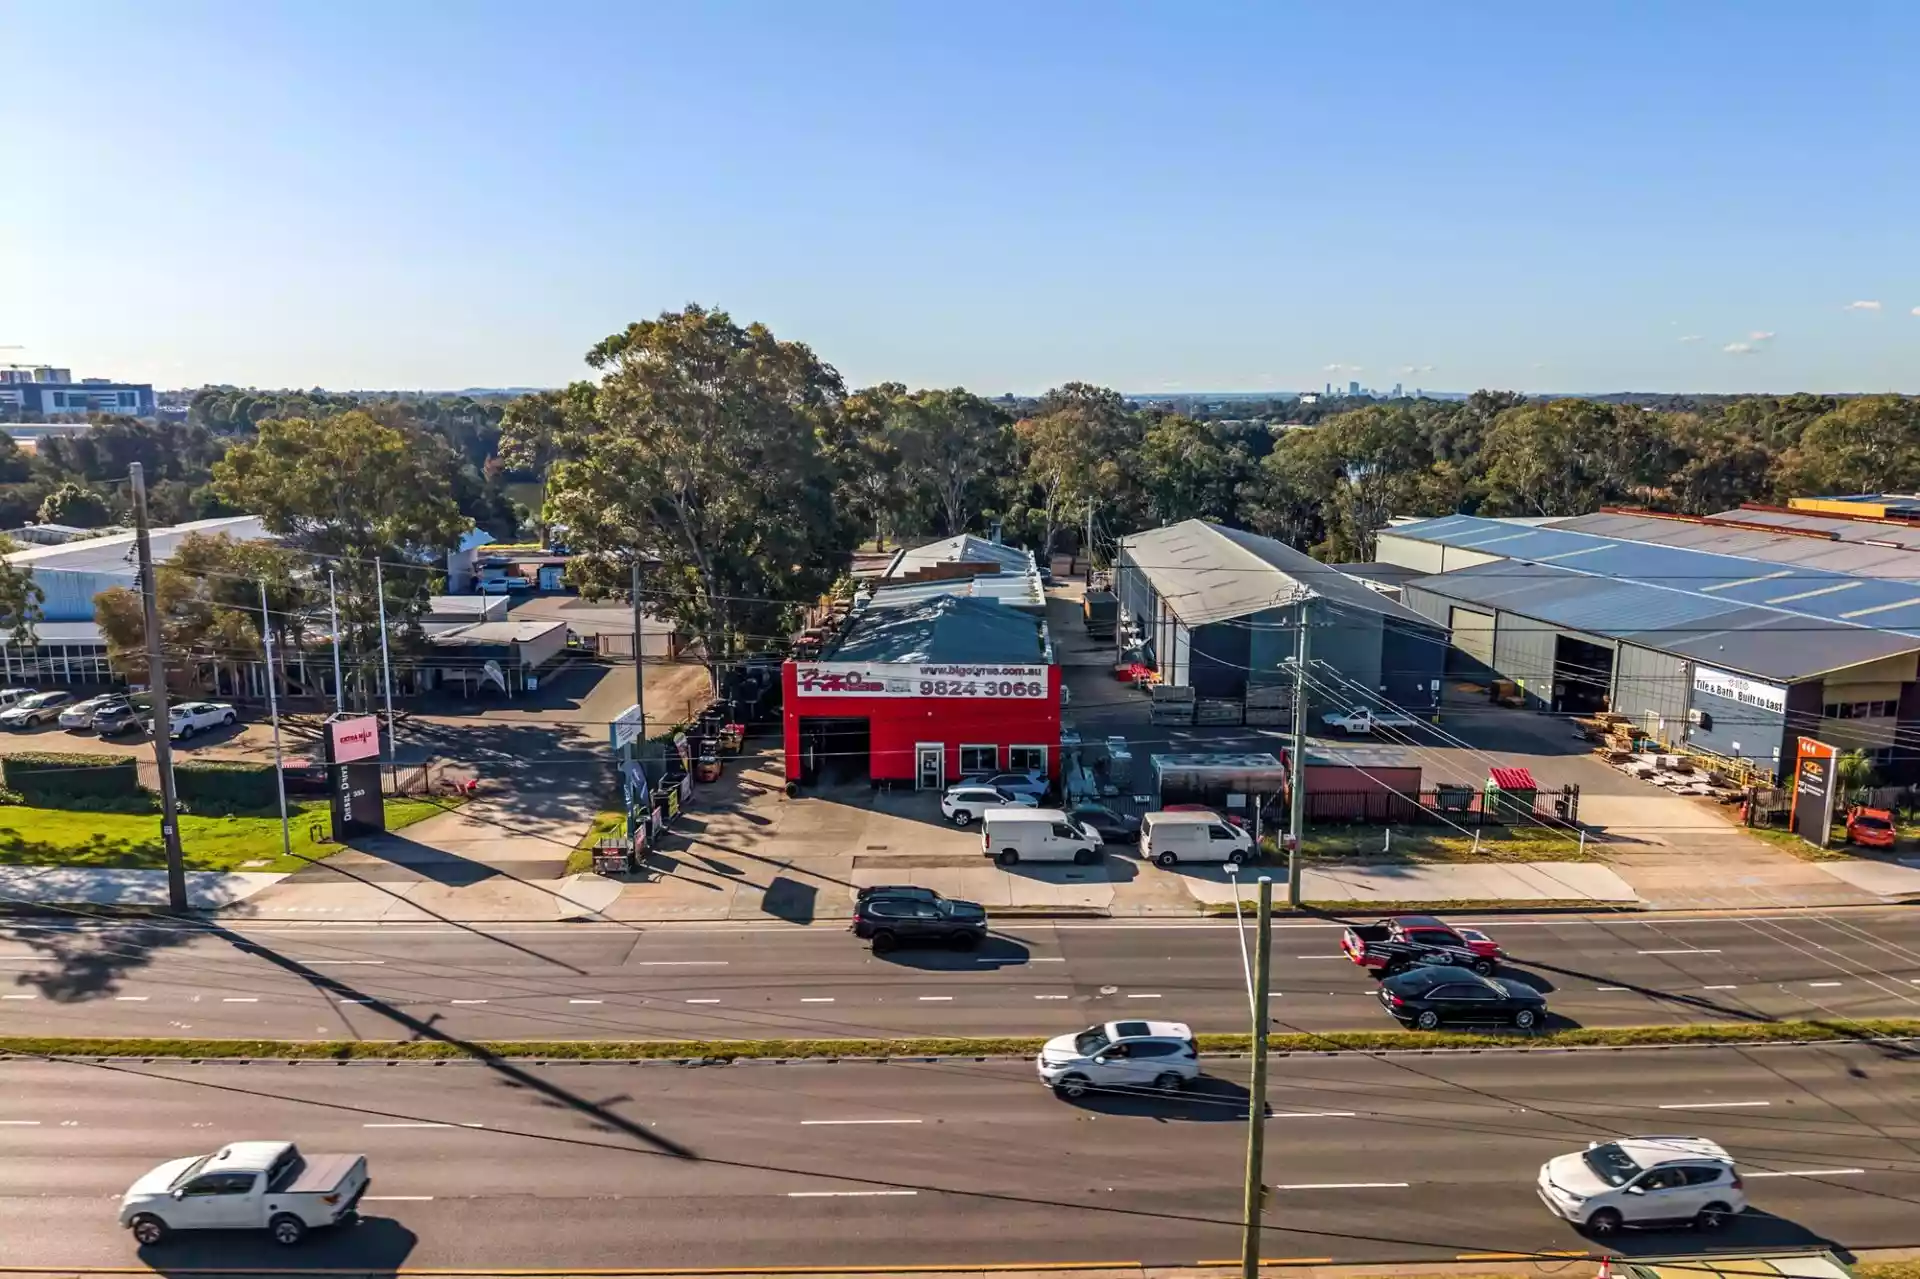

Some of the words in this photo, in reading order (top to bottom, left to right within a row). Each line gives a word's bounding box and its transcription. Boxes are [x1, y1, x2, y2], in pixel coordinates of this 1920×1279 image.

[920, 680, 977, 695] 9824
[984, 681, 1042, 696] 3066
[1696, 680, 1709, 691] Tile
[1717, 685, 1734, 698] Bath
[1738, 691, 1756, 704] Built
[1757, 696, 1765, 707] to
[1766, 699, 1783, 712] Last
